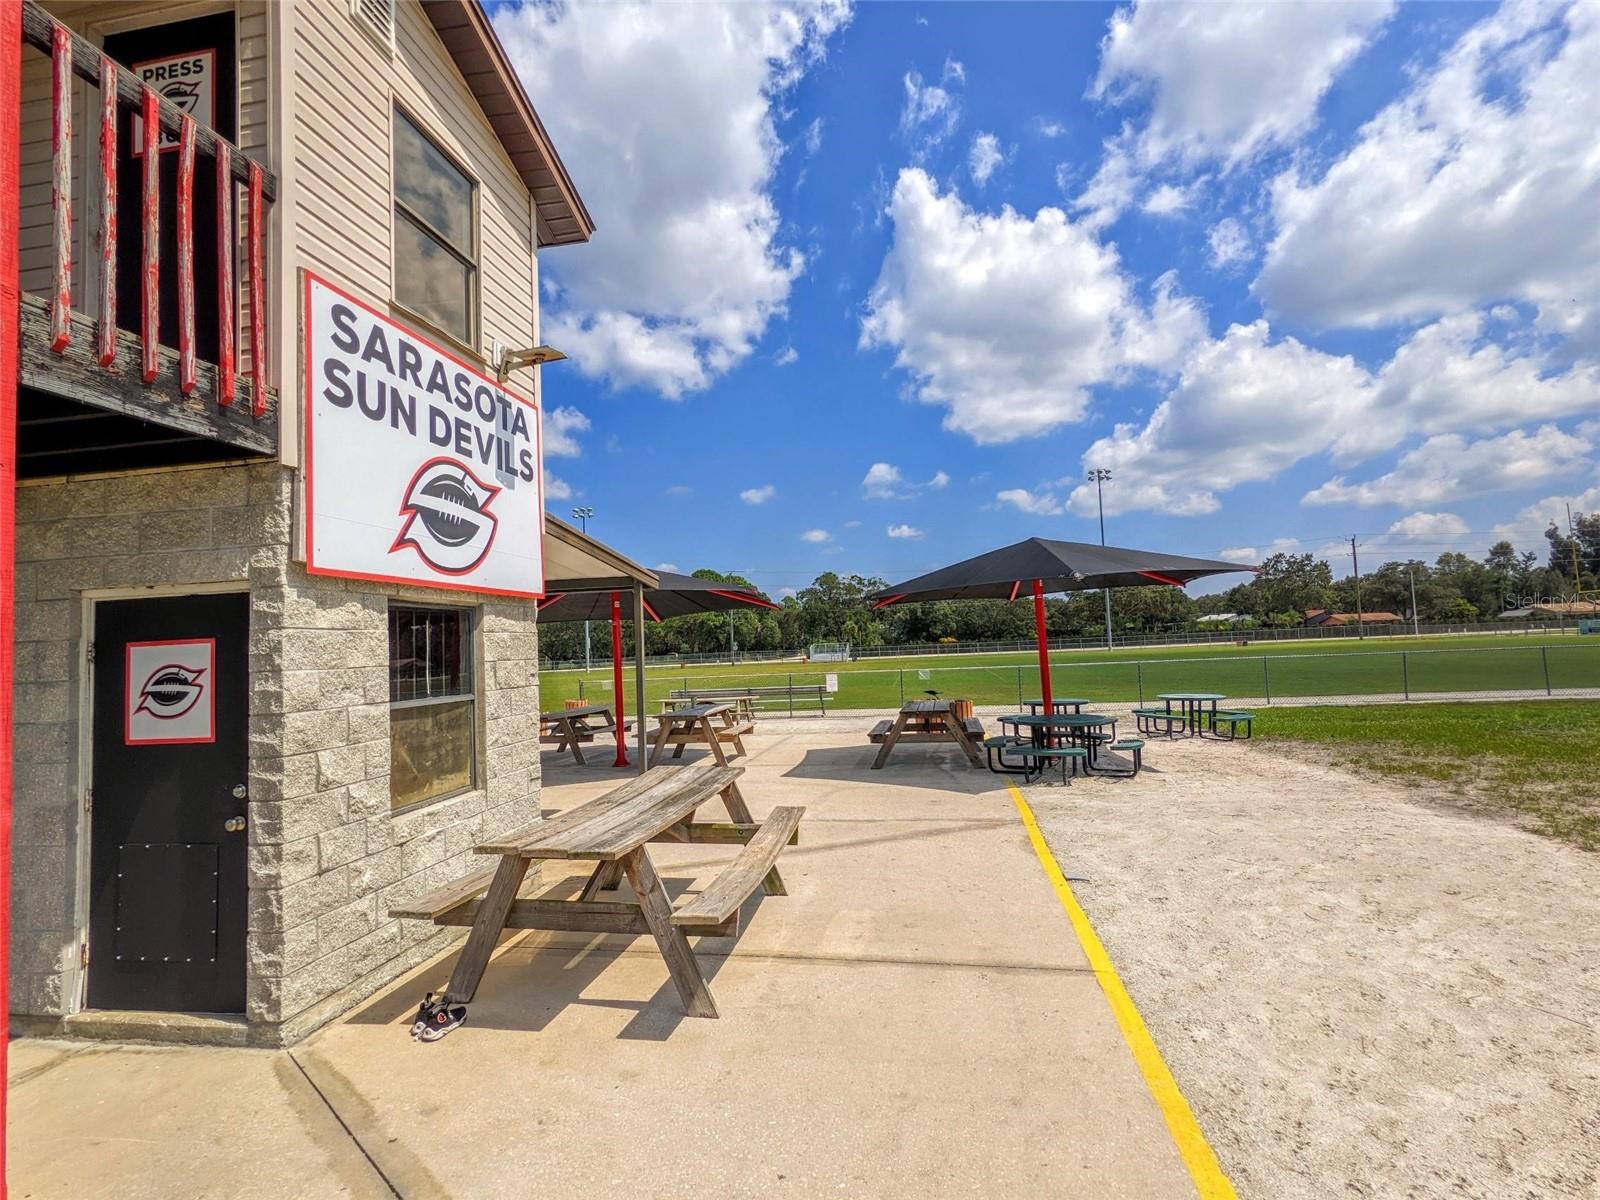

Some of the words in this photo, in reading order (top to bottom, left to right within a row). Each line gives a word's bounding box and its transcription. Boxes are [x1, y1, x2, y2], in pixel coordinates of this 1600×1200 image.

[143, 58, 204, 82] PRESS
[323, 358, 417, 437] SUN
[429, 404, 534, 482] DEVILS
[330, 303, 530, 442] SARASOTA
